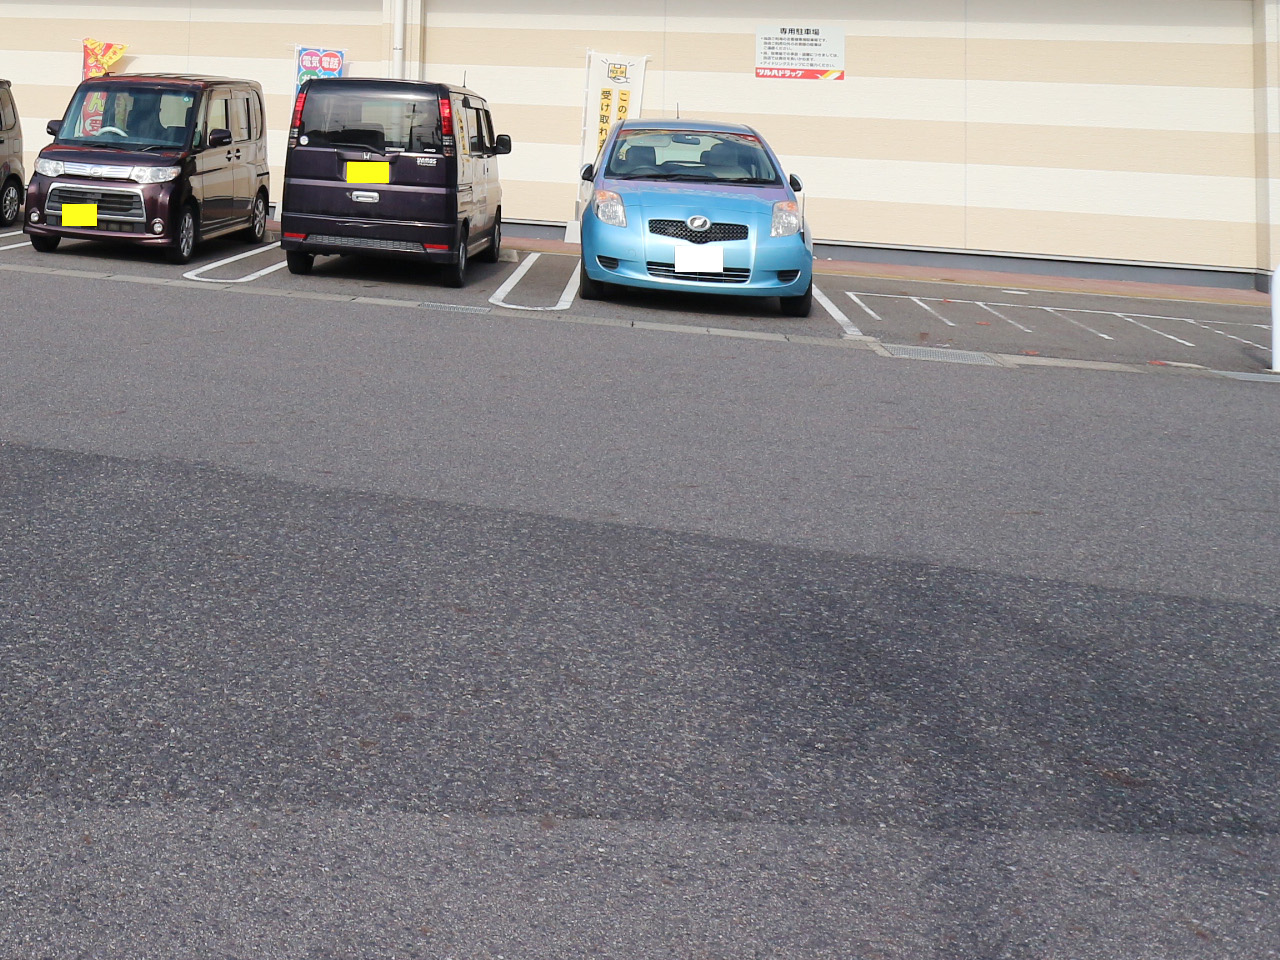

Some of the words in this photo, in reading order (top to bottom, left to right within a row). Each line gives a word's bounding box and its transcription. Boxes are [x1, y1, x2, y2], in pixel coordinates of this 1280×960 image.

[303, 55, 319, 68] 電気
[322, 56, 339, 69] 電話
[617, 92, 627, 120] この
